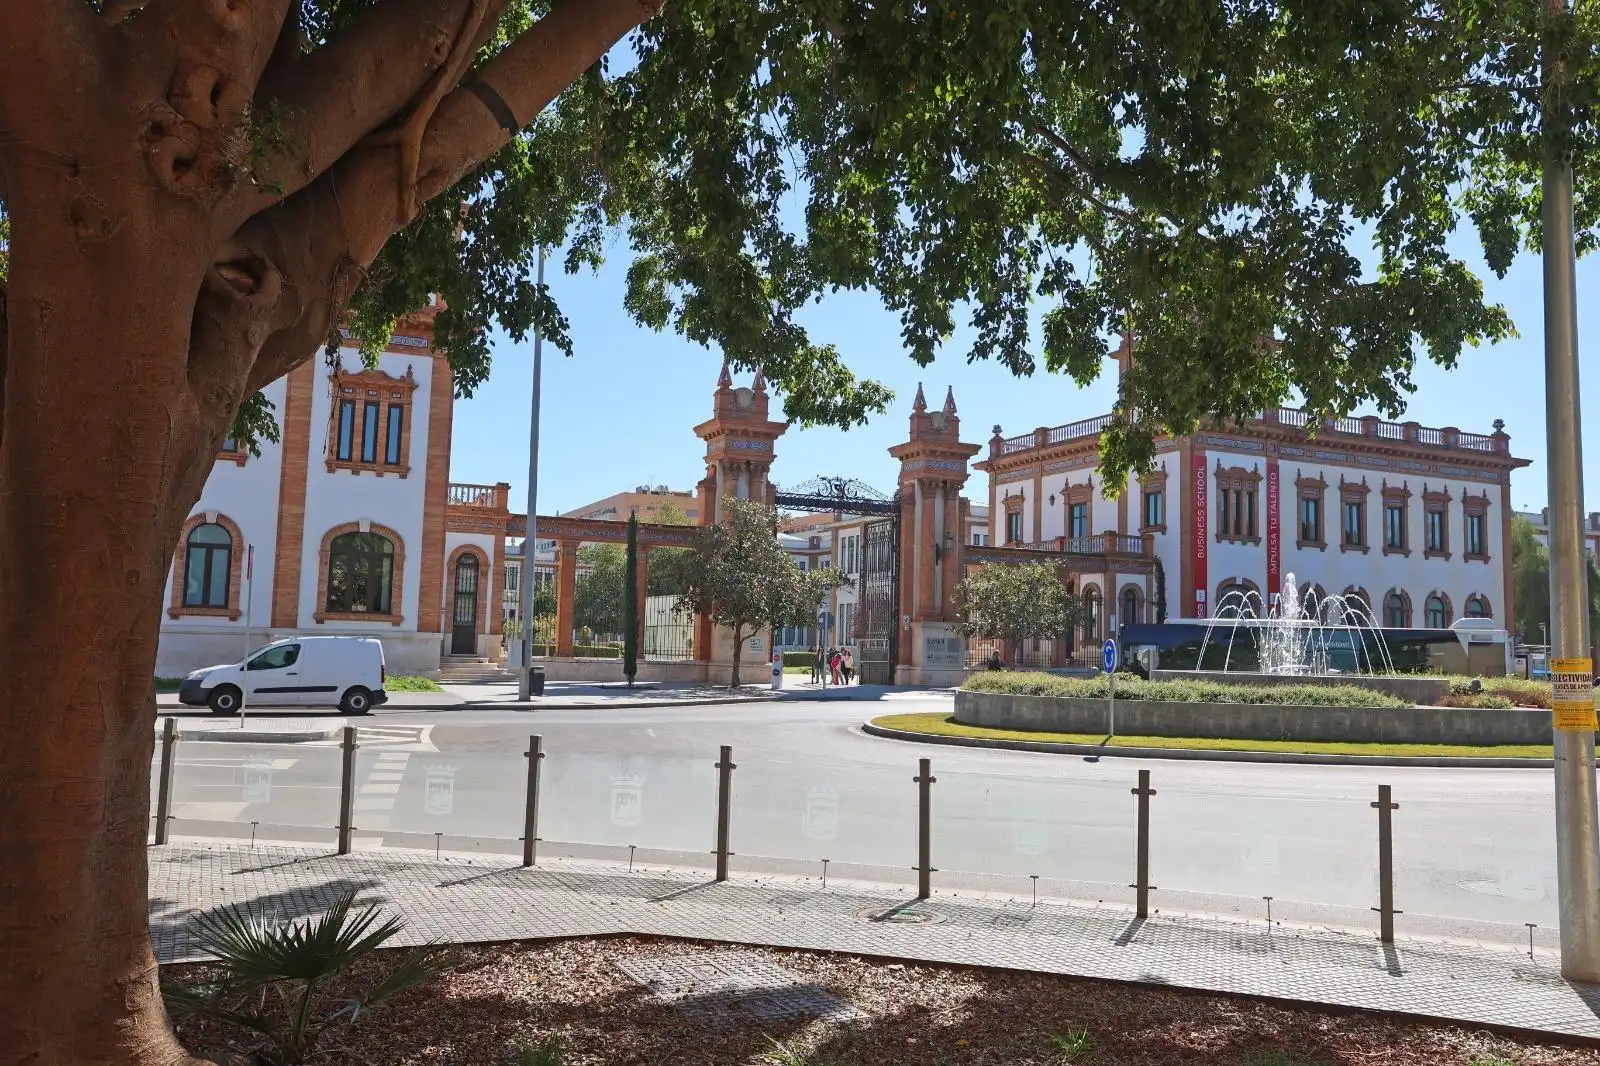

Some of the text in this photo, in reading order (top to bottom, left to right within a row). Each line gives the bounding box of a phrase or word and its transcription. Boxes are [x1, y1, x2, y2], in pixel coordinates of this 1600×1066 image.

[1197, 466, 1205, 559] BUSINESS SCHOOL
[1270, 518, 1277, 530] TU
